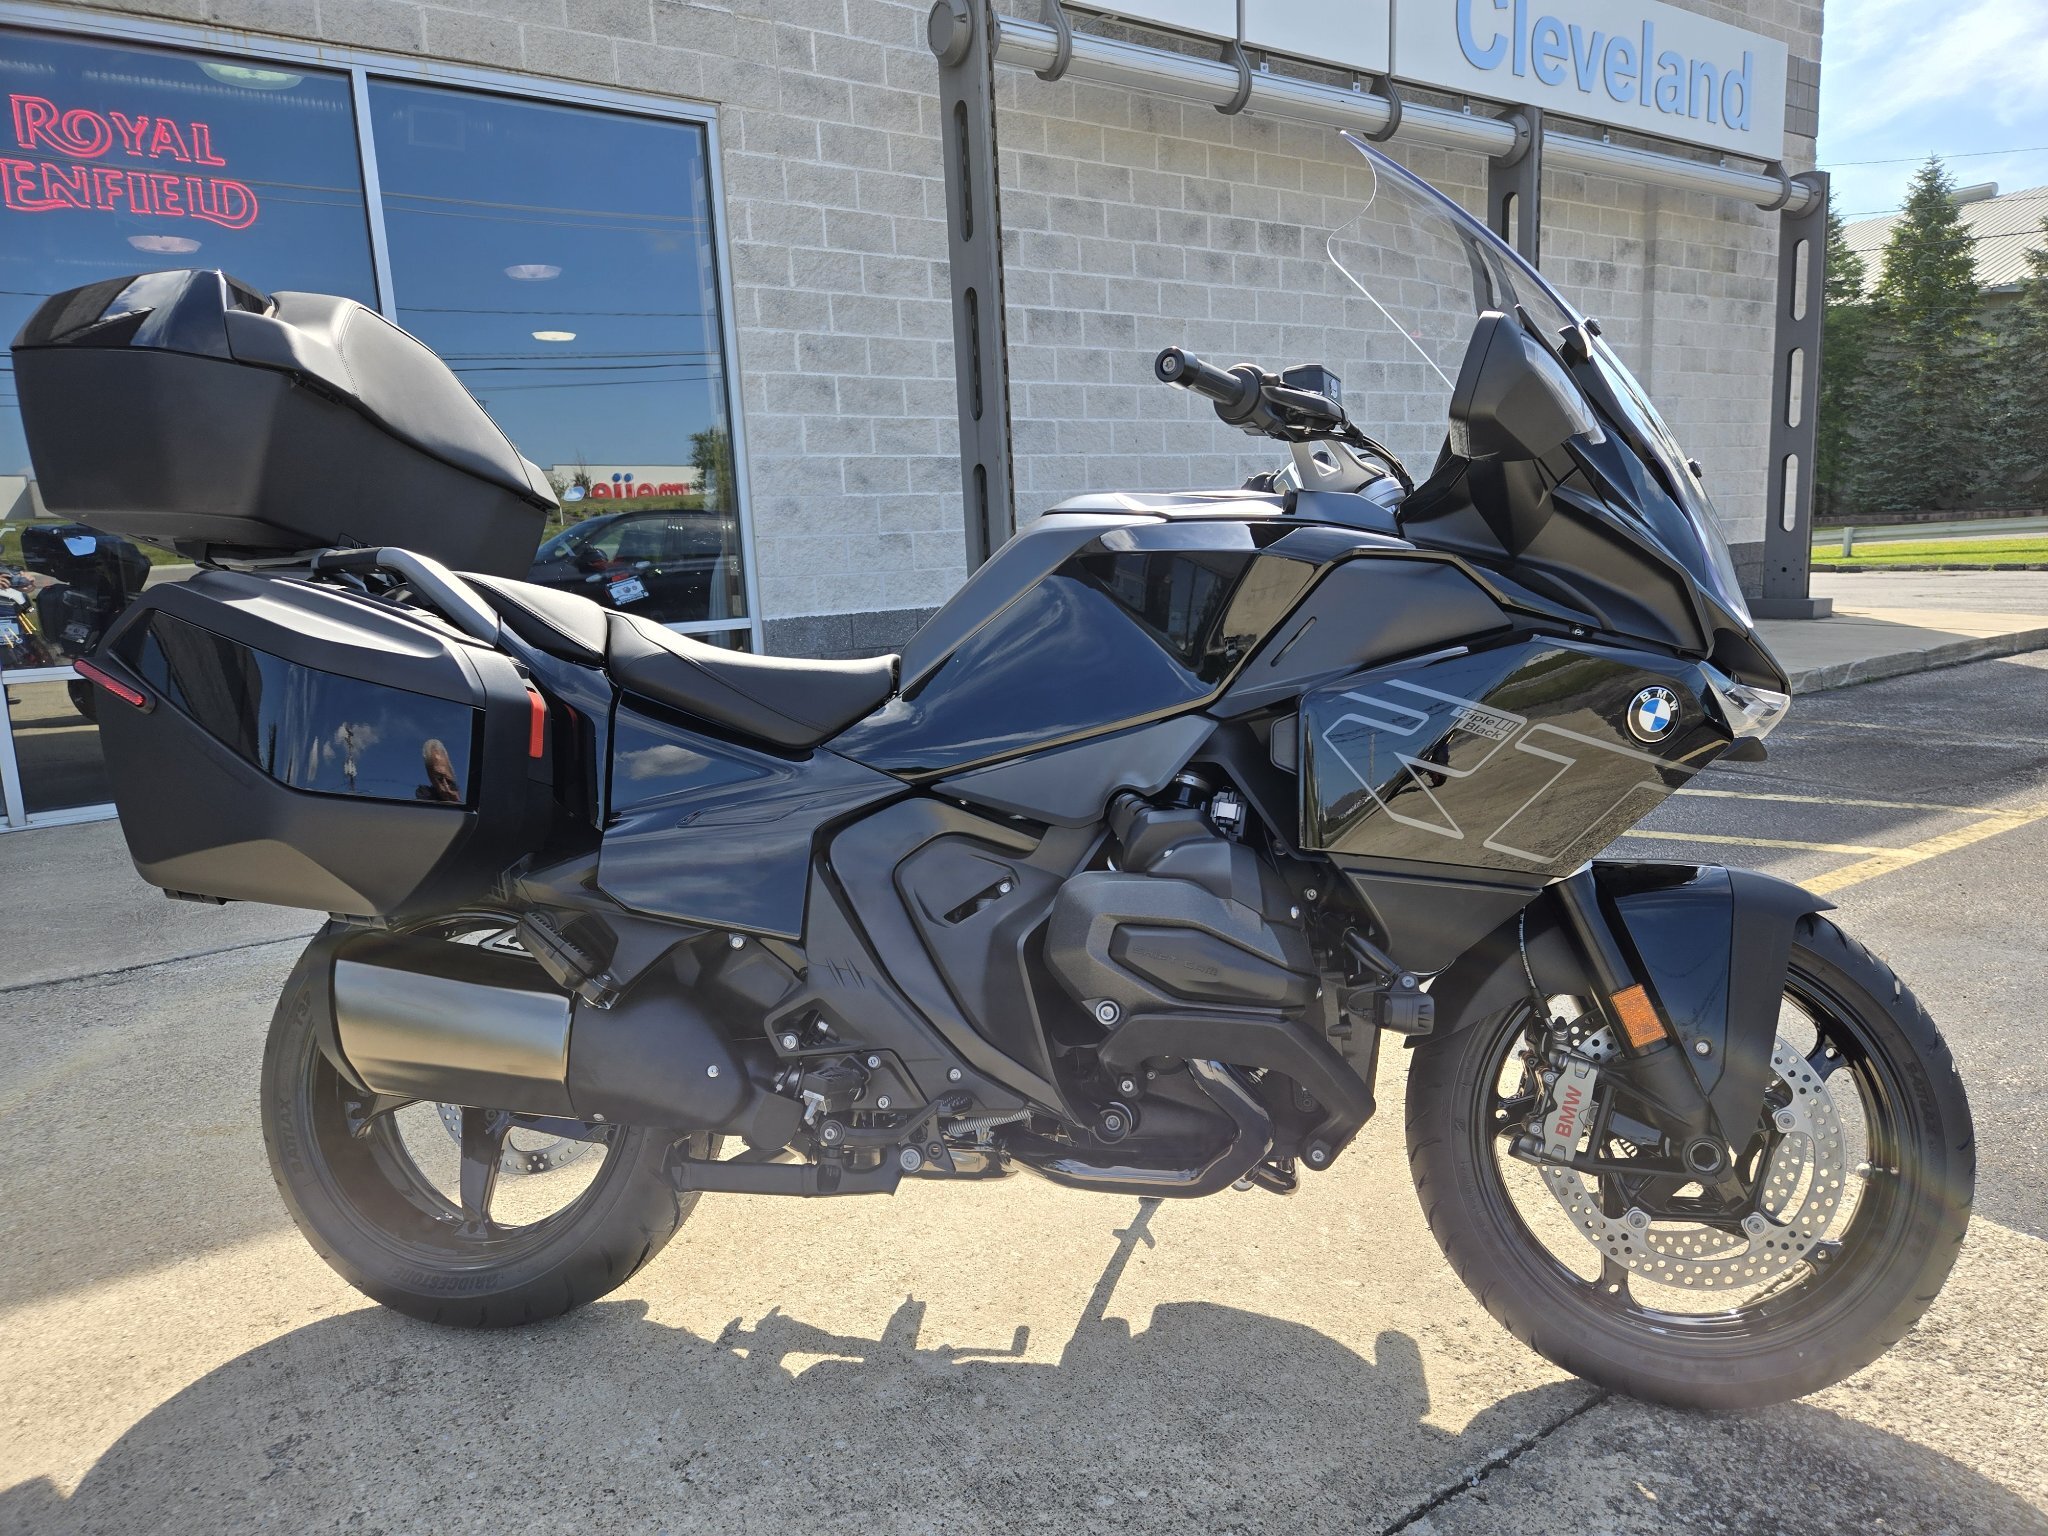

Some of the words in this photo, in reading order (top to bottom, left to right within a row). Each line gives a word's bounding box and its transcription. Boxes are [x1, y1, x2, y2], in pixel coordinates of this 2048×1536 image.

[1455, 0, 1753, 131] Cleveland
[9, 94, 226, 167] ROYAL
[0, 158, 259, 229] ENFIELD
[1458, 708, 1495, 726] Triple
[1639, 689, 1679, 711] BMW
[1462, 721, 1502, 739] Black
[1555, 1085, 1582, 1138] BMW
